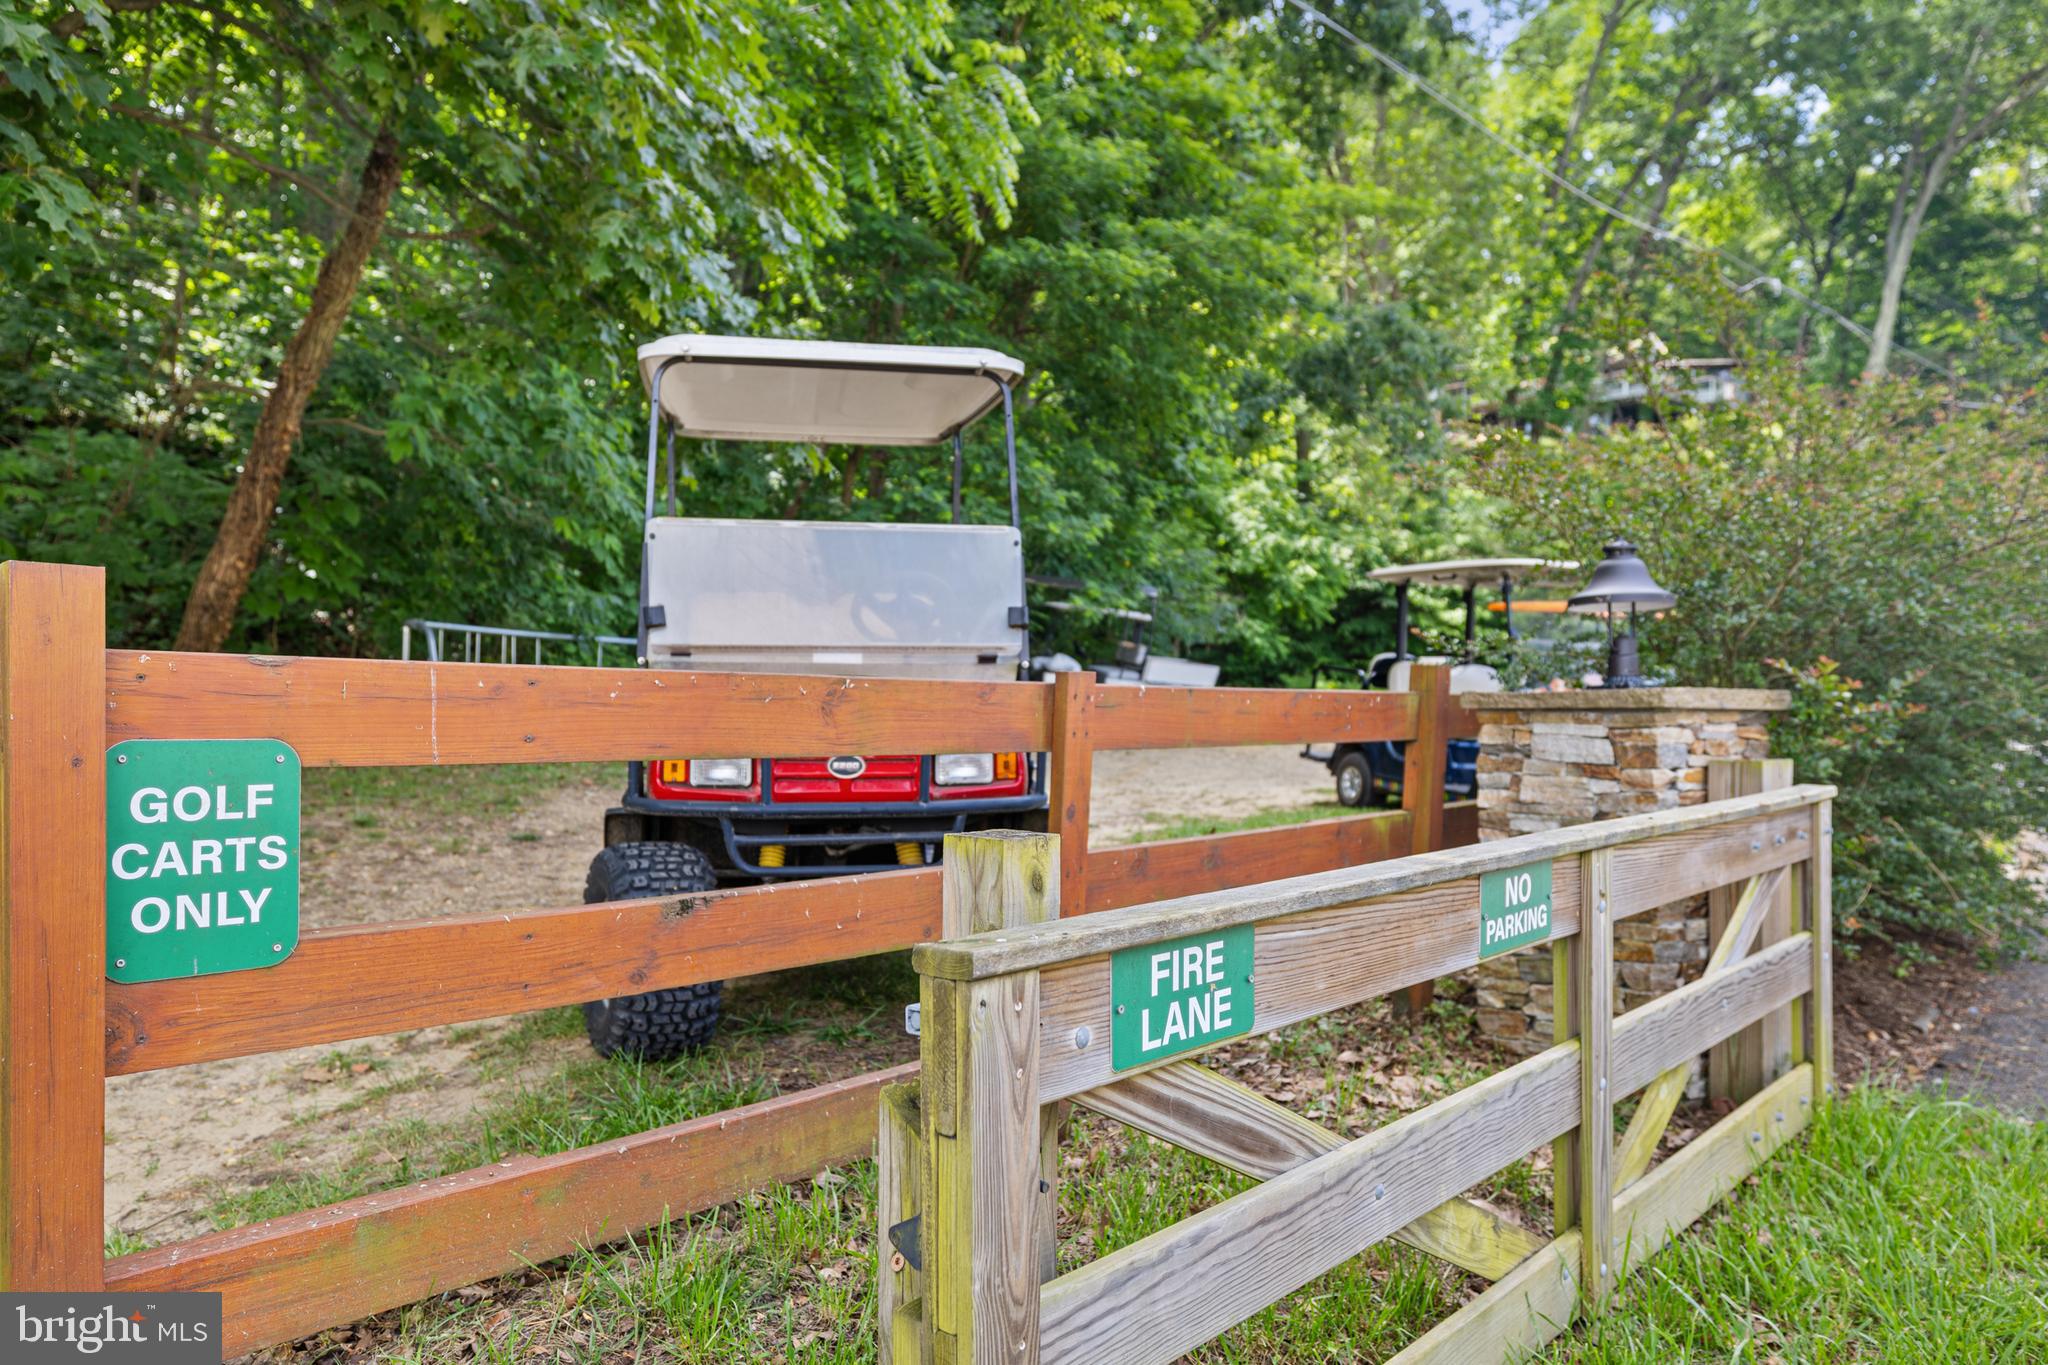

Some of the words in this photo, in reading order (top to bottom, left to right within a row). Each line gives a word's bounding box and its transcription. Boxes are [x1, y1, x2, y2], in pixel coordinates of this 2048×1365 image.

[130, 784, 274, 824] GOLF
[111, 835, 288, 880] CARTS
[131, 888, 272, 934] ONLY
[1505, 873, 1532, 908] NO
[1486, 904, 1548, 945] PARKING
[1151, 940, 1224, 997] FIRE
[1141, 987, 1232, 1052] LANE
